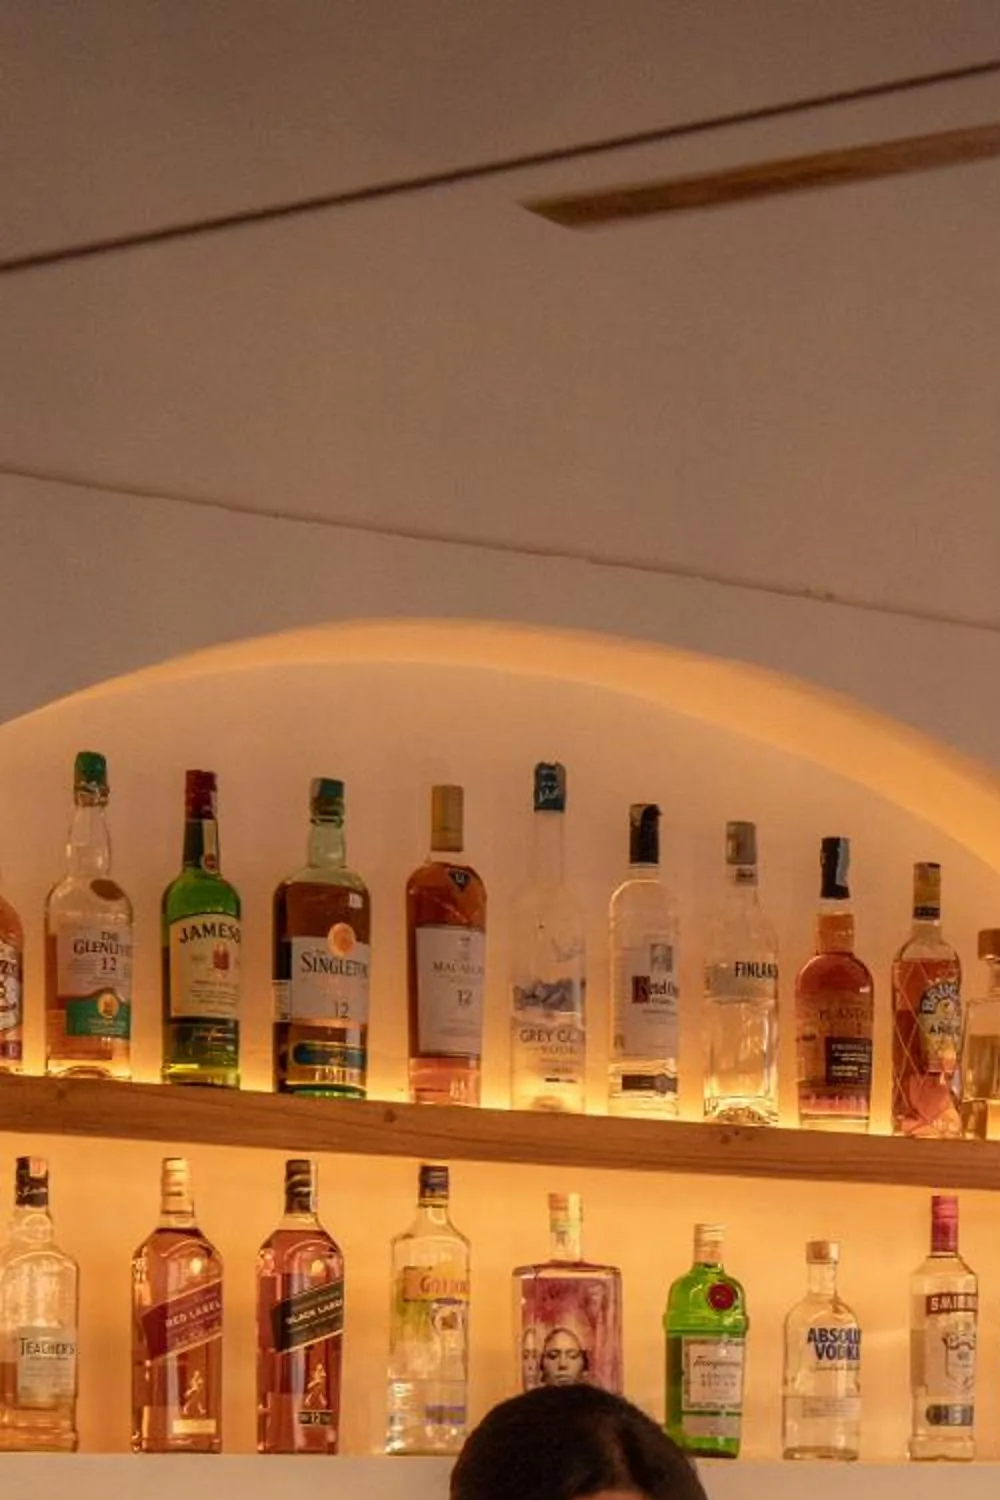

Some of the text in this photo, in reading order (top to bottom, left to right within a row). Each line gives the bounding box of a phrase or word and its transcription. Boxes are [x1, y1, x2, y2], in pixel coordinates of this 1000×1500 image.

[101, 957, 117, 971] 12
[457, 989, 473, 1006] 12
[335, 1001, 350, 1018] 12
